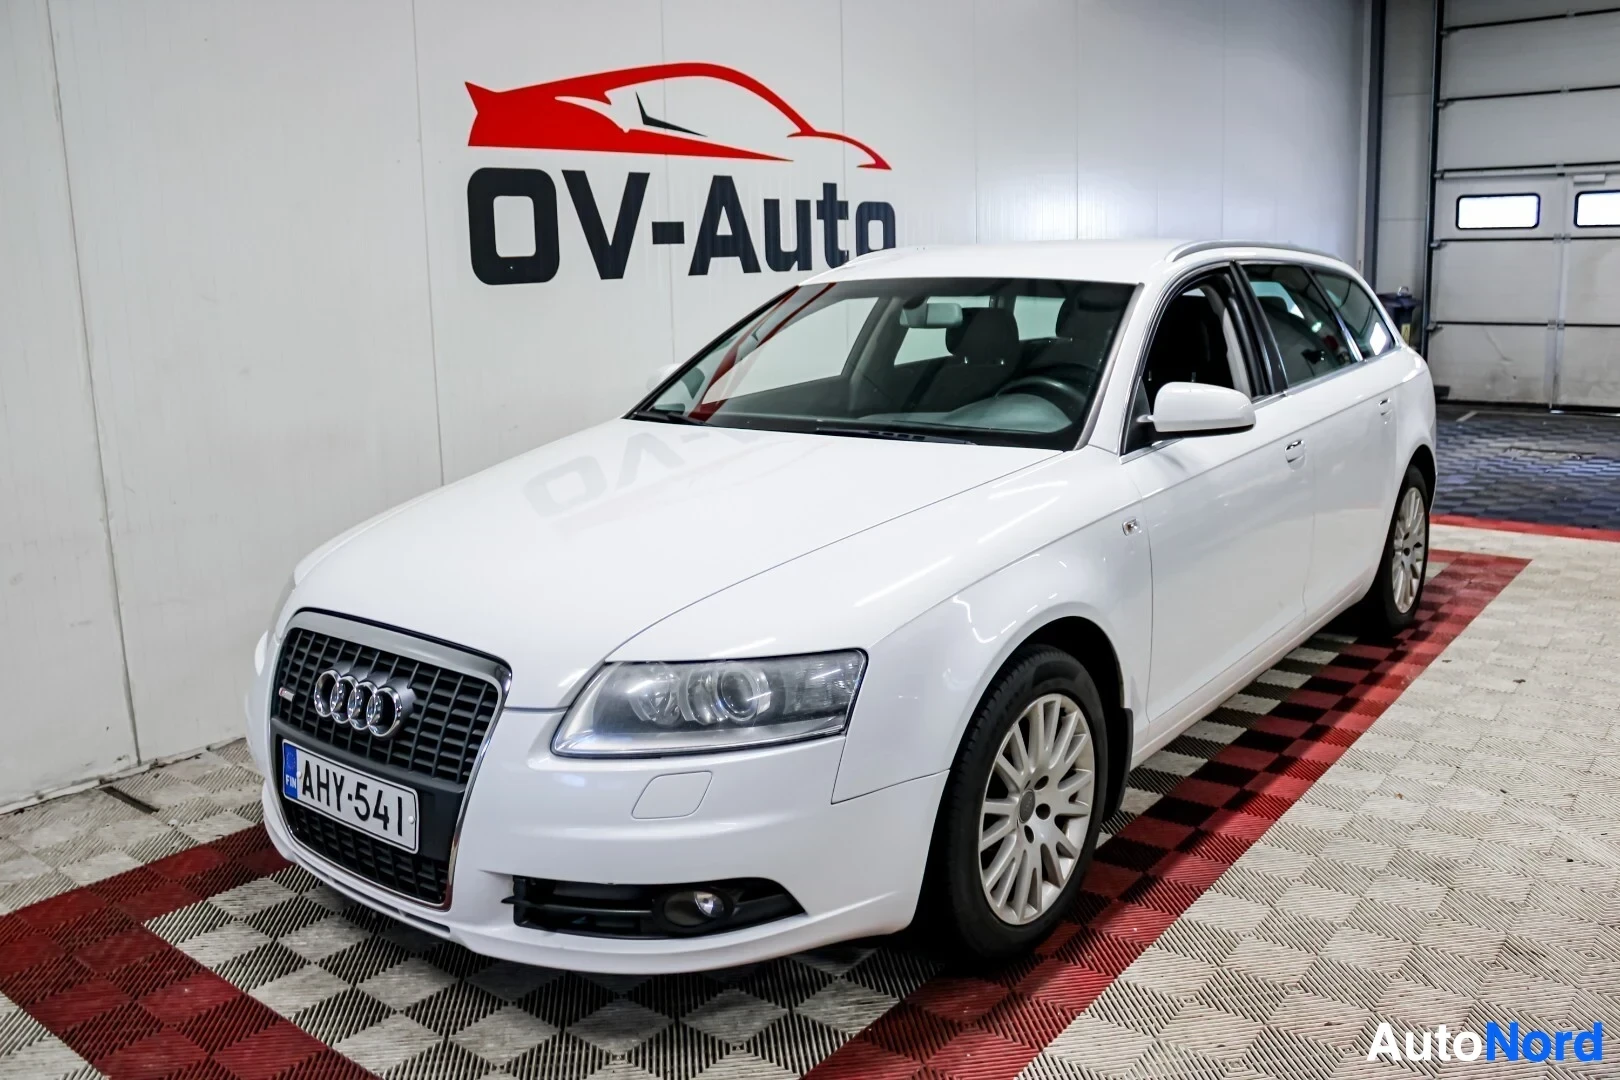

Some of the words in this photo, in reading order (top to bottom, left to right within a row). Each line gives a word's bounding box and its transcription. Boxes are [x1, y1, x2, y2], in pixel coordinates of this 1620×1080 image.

[467, 167, 896, 286] OV-Auto
[285, 774, 297, 789] FIN
[302, 759, 403, 837] AHY-541
